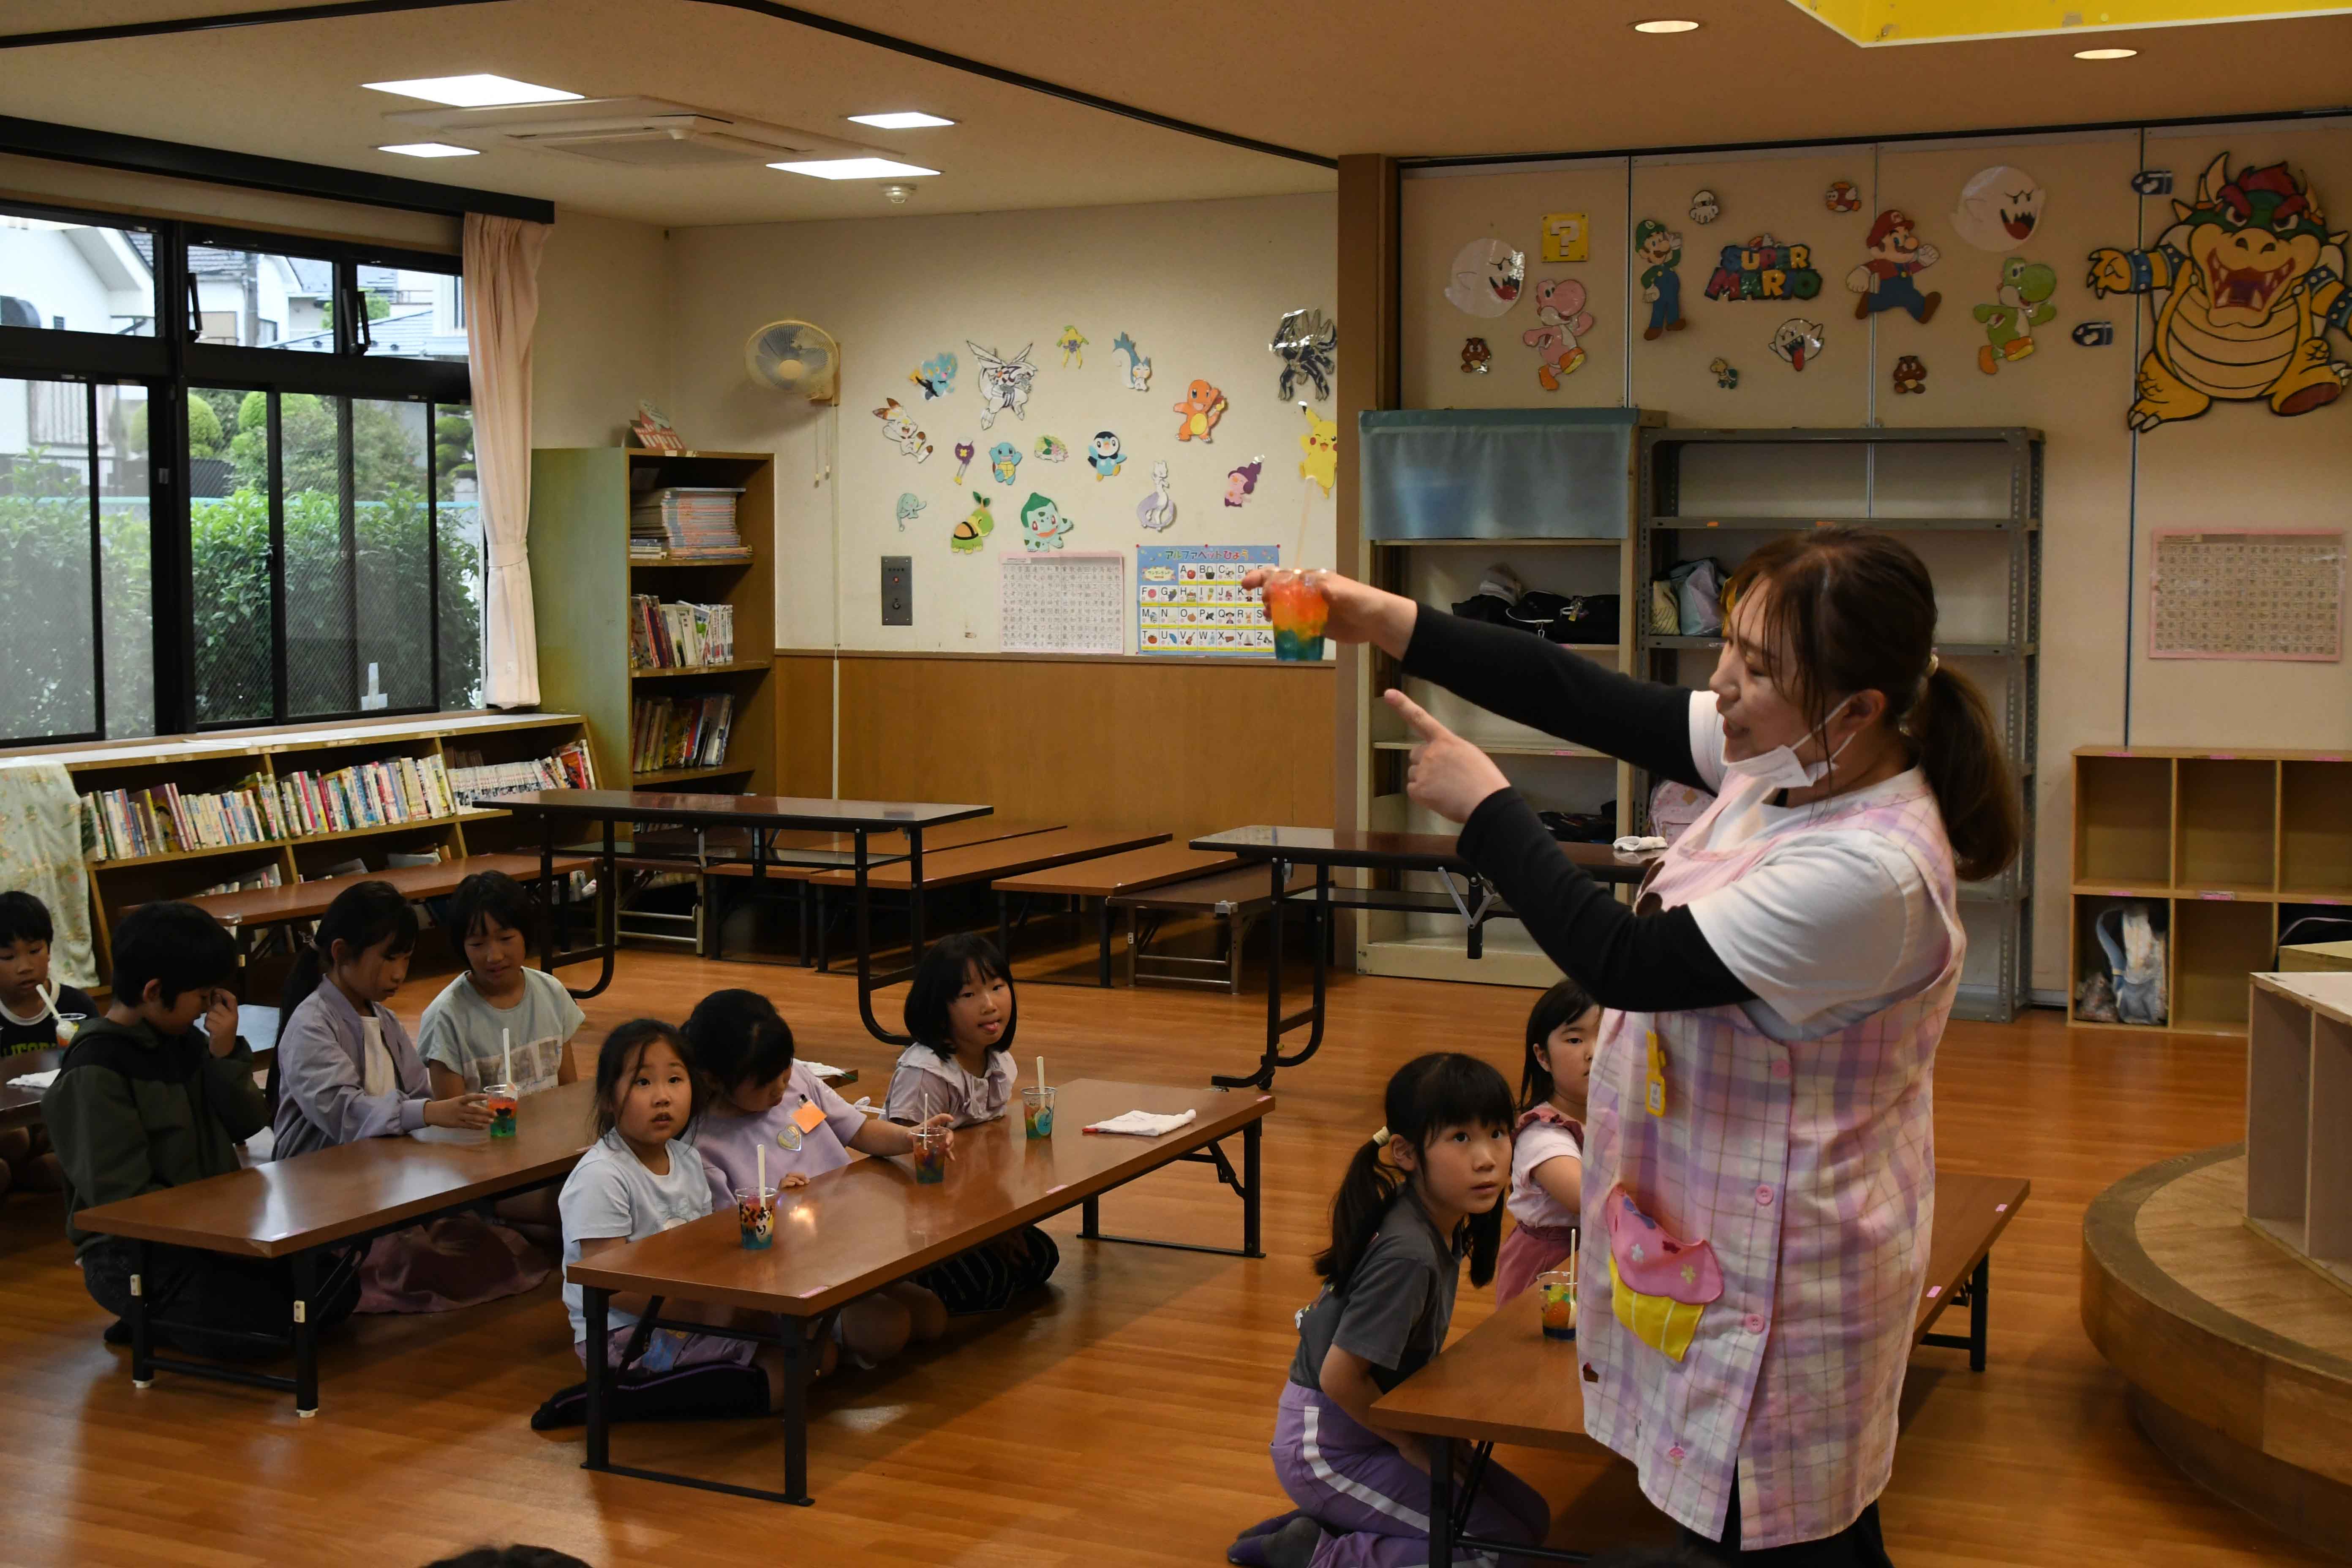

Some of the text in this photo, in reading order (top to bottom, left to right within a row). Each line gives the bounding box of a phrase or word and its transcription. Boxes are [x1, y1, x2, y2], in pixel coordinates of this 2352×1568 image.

[1721, 244, 1810, 271] SUPER
[1705, 267, 1823, 301] MARIO
[1180, 565, 1244, 573] A B C D
[1142, 587, 1147, 595] F
[1161, 587, 1168, 595] G
[1181, 587, 1187, 595] H
[1219, 588, 1223, 596] J
[1181, 609, 1187, 617] O
[1200, 609, 1205, 617] P
[1218, 610, 1225, 618] Q
[1257, 610, 1263, 618] S
[1238, 632, 1243, 640] Y
